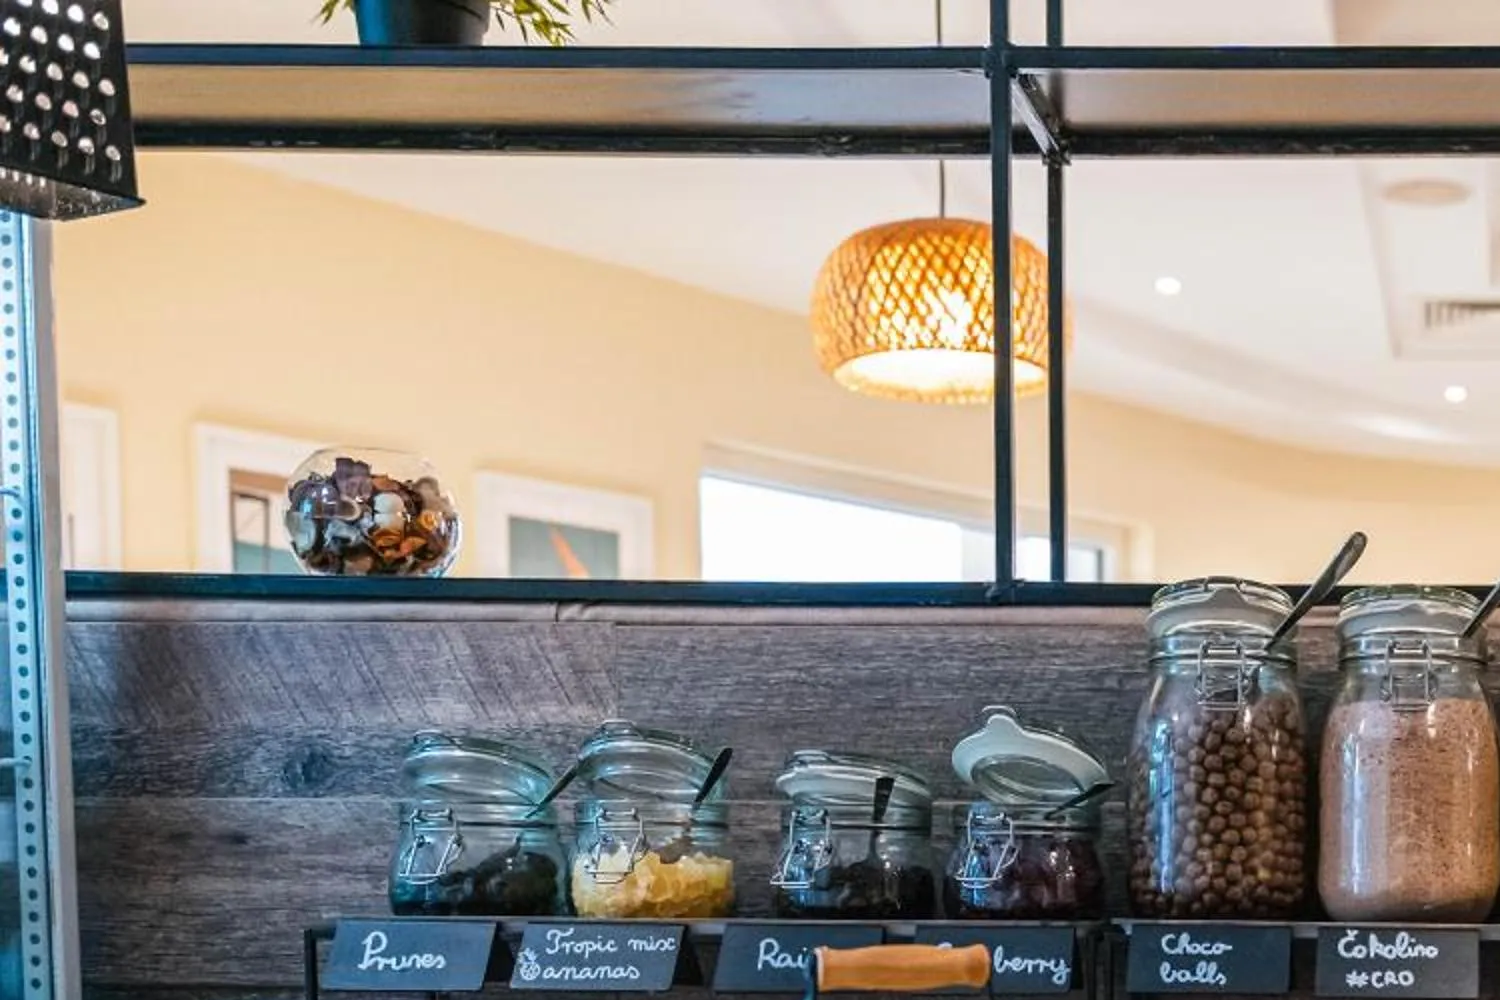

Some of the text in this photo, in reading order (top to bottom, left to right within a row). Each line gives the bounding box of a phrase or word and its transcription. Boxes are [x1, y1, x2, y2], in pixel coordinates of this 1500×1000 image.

[358, 931, 446, 969] Prunes
[546, 928, 676, 958] Tropic mix
[1161, 932, 1233, 955] Choco
[1338, 929, 1439, 960] Čokolino
[542, 964, 641, 981] ananas
[1160, 961, 1227, 986] balls
